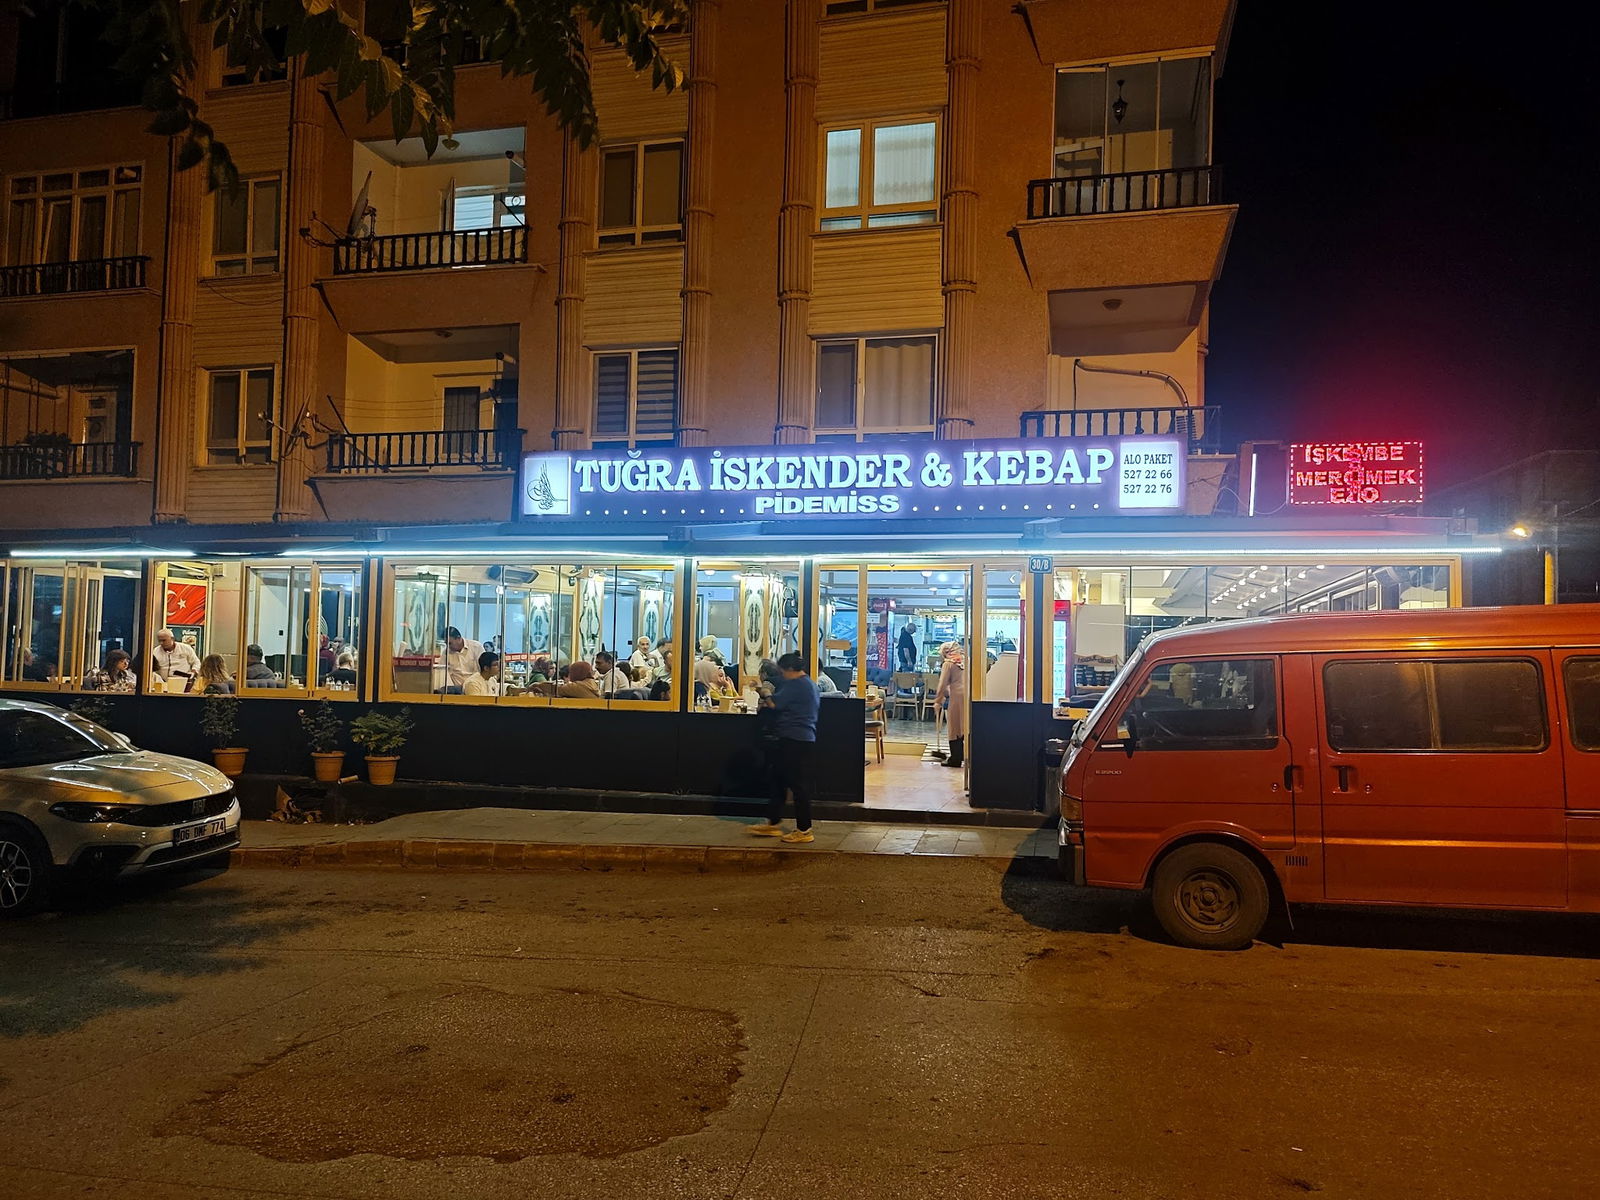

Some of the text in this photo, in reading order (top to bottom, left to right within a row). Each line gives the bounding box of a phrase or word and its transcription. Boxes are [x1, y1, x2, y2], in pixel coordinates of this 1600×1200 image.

[1123, 454, 1173, 465] ALO PAKET
[574, 448, 1114, 492] TUĞRA İSKENDER & KEBAP
[1123, 469, 1173, 479] 527 22 66
[1123, 483, 1172, 494] 527 22 76
[211, 821, 224, 834] 774
